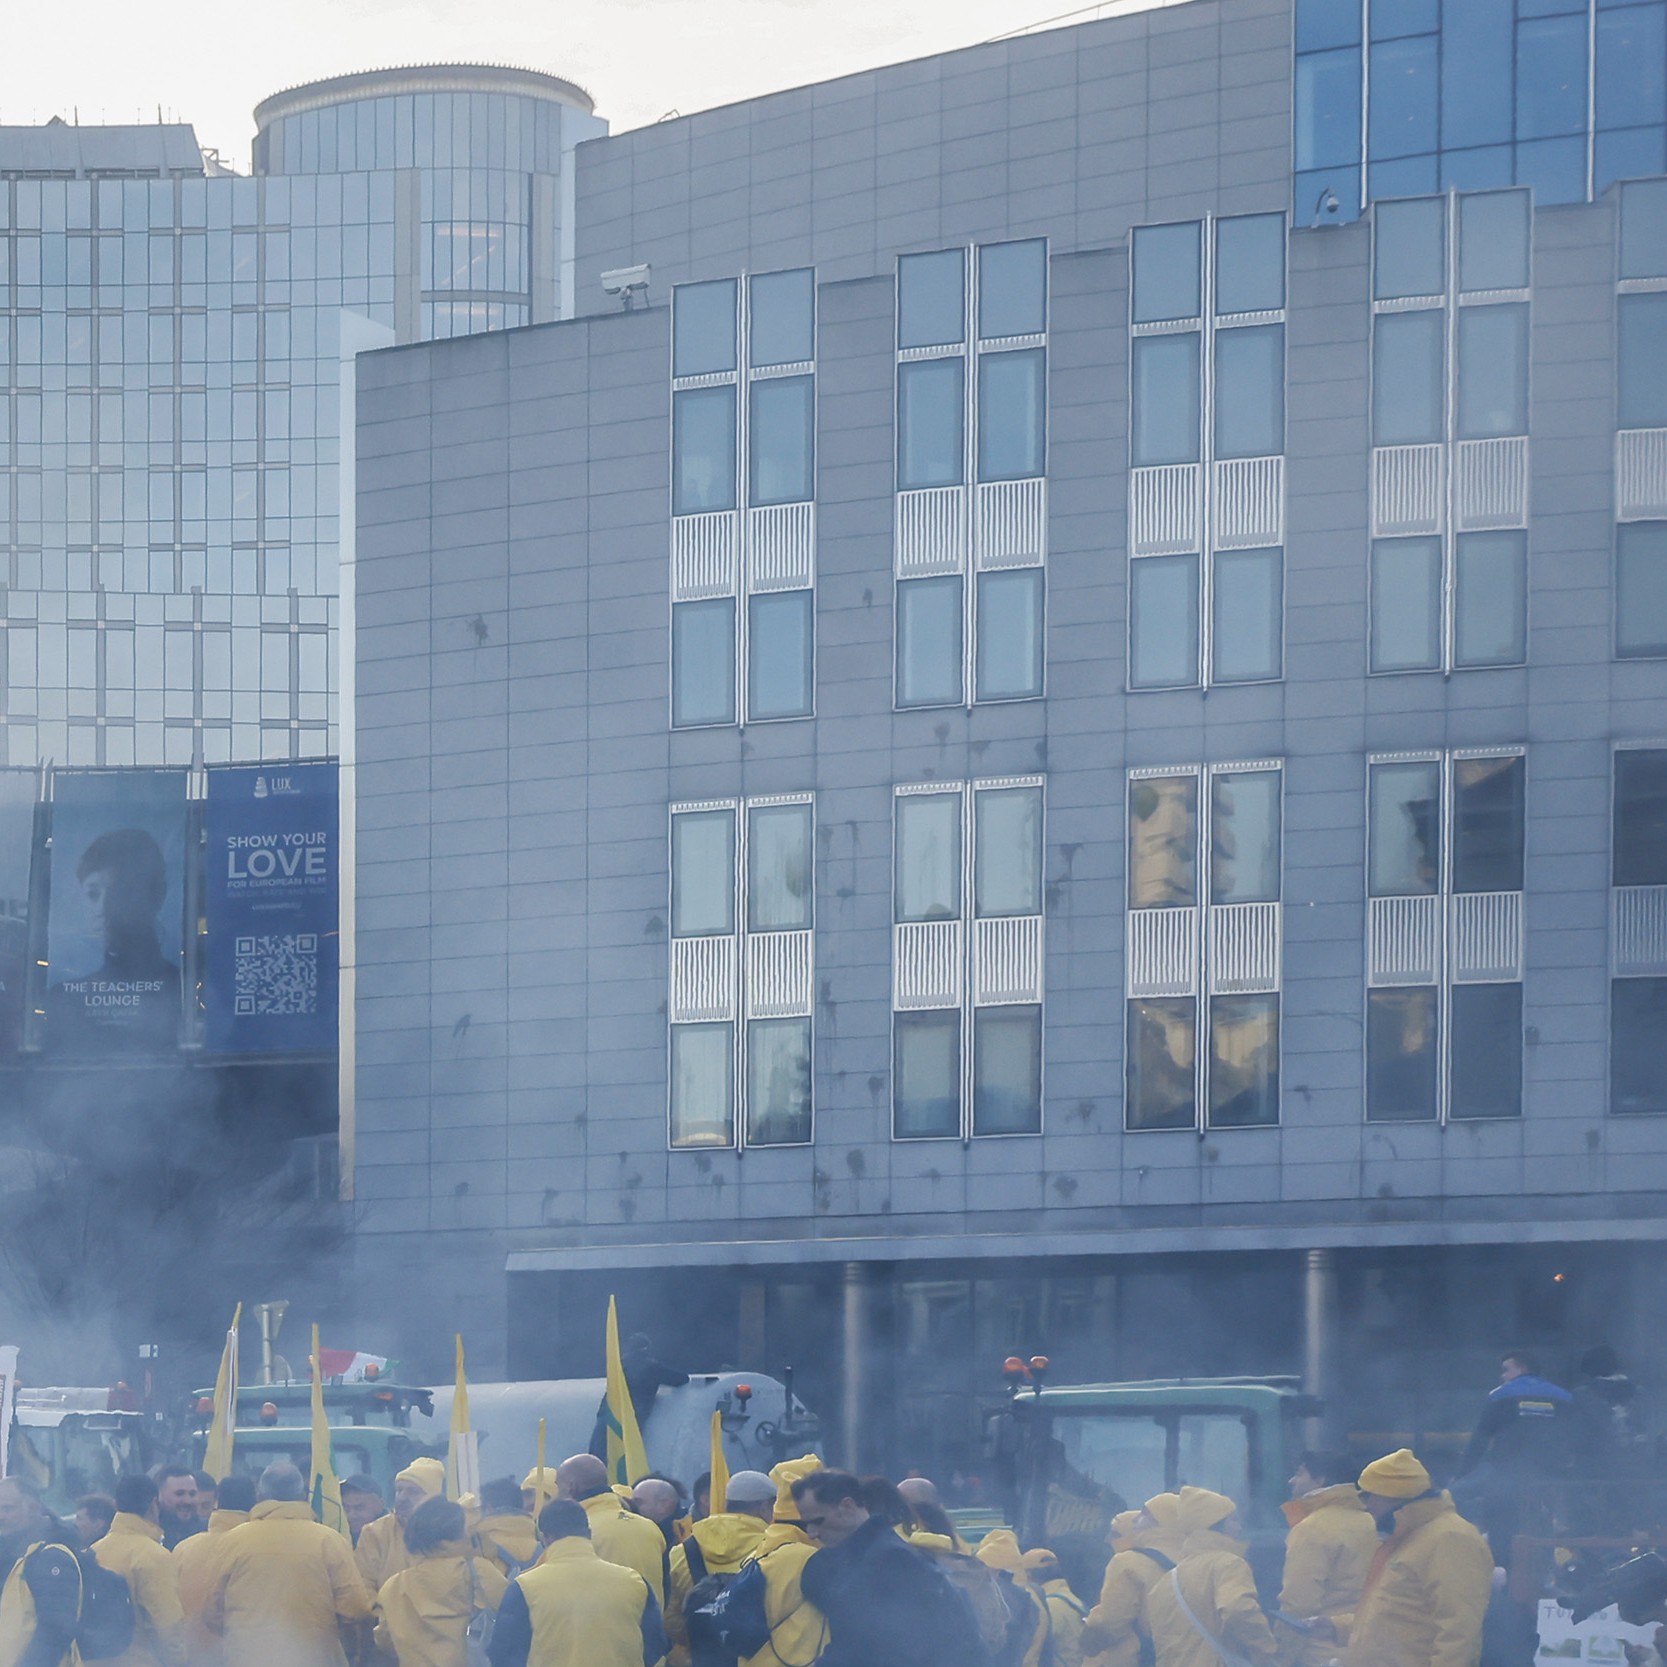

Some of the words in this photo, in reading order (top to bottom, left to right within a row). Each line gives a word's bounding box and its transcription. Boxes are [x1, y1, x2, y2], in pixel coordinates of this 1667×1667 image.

[271, 777, 291, 790] LUX
[227, 834, 277, 848] SHOW
[283, 832, 326, 846] YOUR
[228, 847, 326, 878] LOVE
[227, 880, 247, 888] FOR
[249, 878, 302, 888] EUROPEAN
[304, 876, 326, 885] FILM
[63, 982, 88, 992] THE
[85, 995, 140, 1006] LOUNGE
